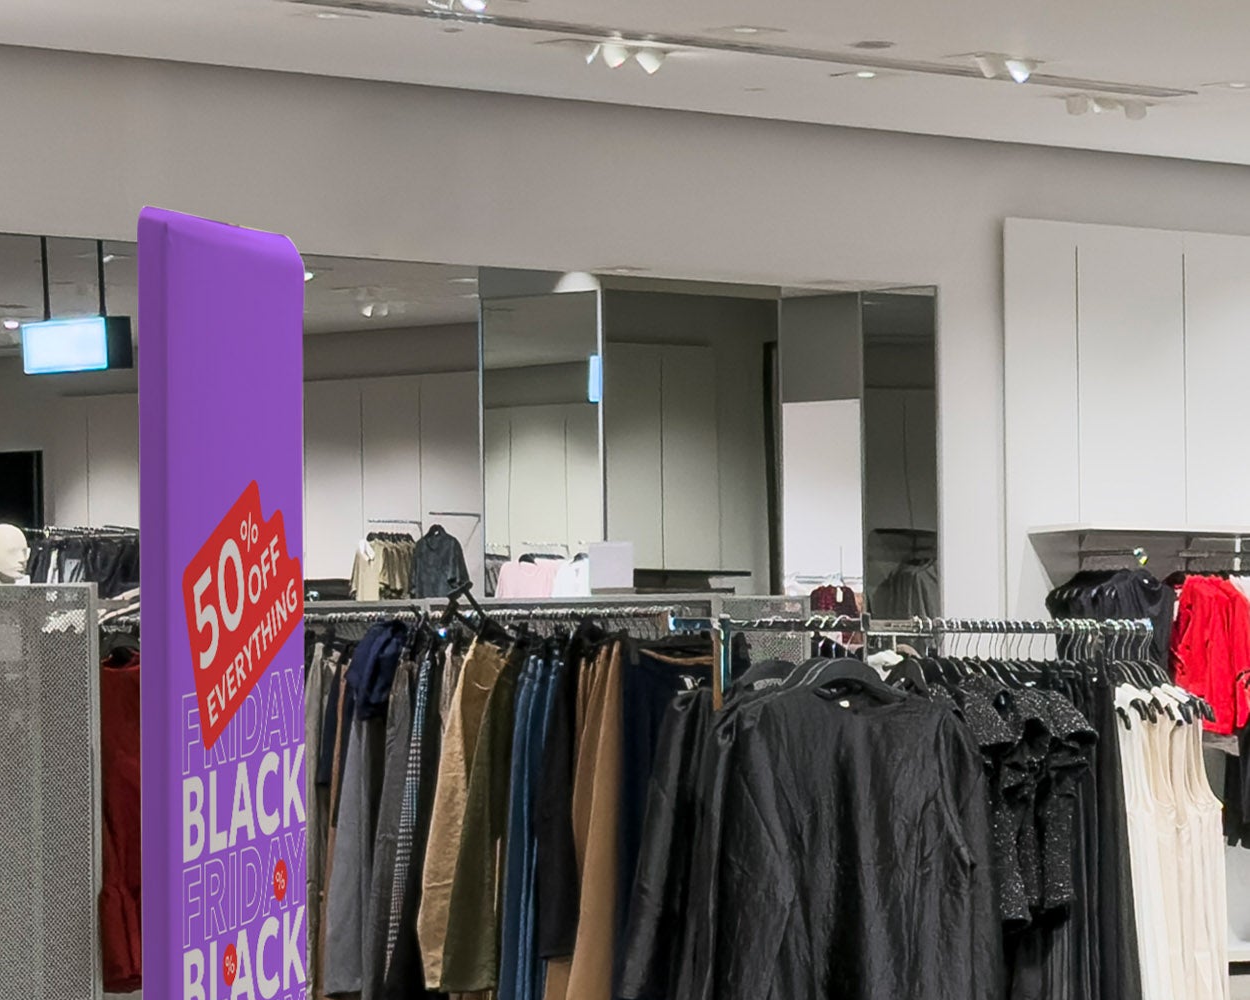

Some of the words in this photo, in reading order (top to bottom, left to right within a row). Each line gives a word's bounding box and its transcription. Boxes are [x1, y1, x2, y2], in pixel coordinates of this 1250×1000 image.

[248, 535, 280, 604] OFF
[207, 578, 298, 728] EVERYTHING
[182, 744, 306, 863] BLACK
[183, 827, 306, 948] FRIDAY
